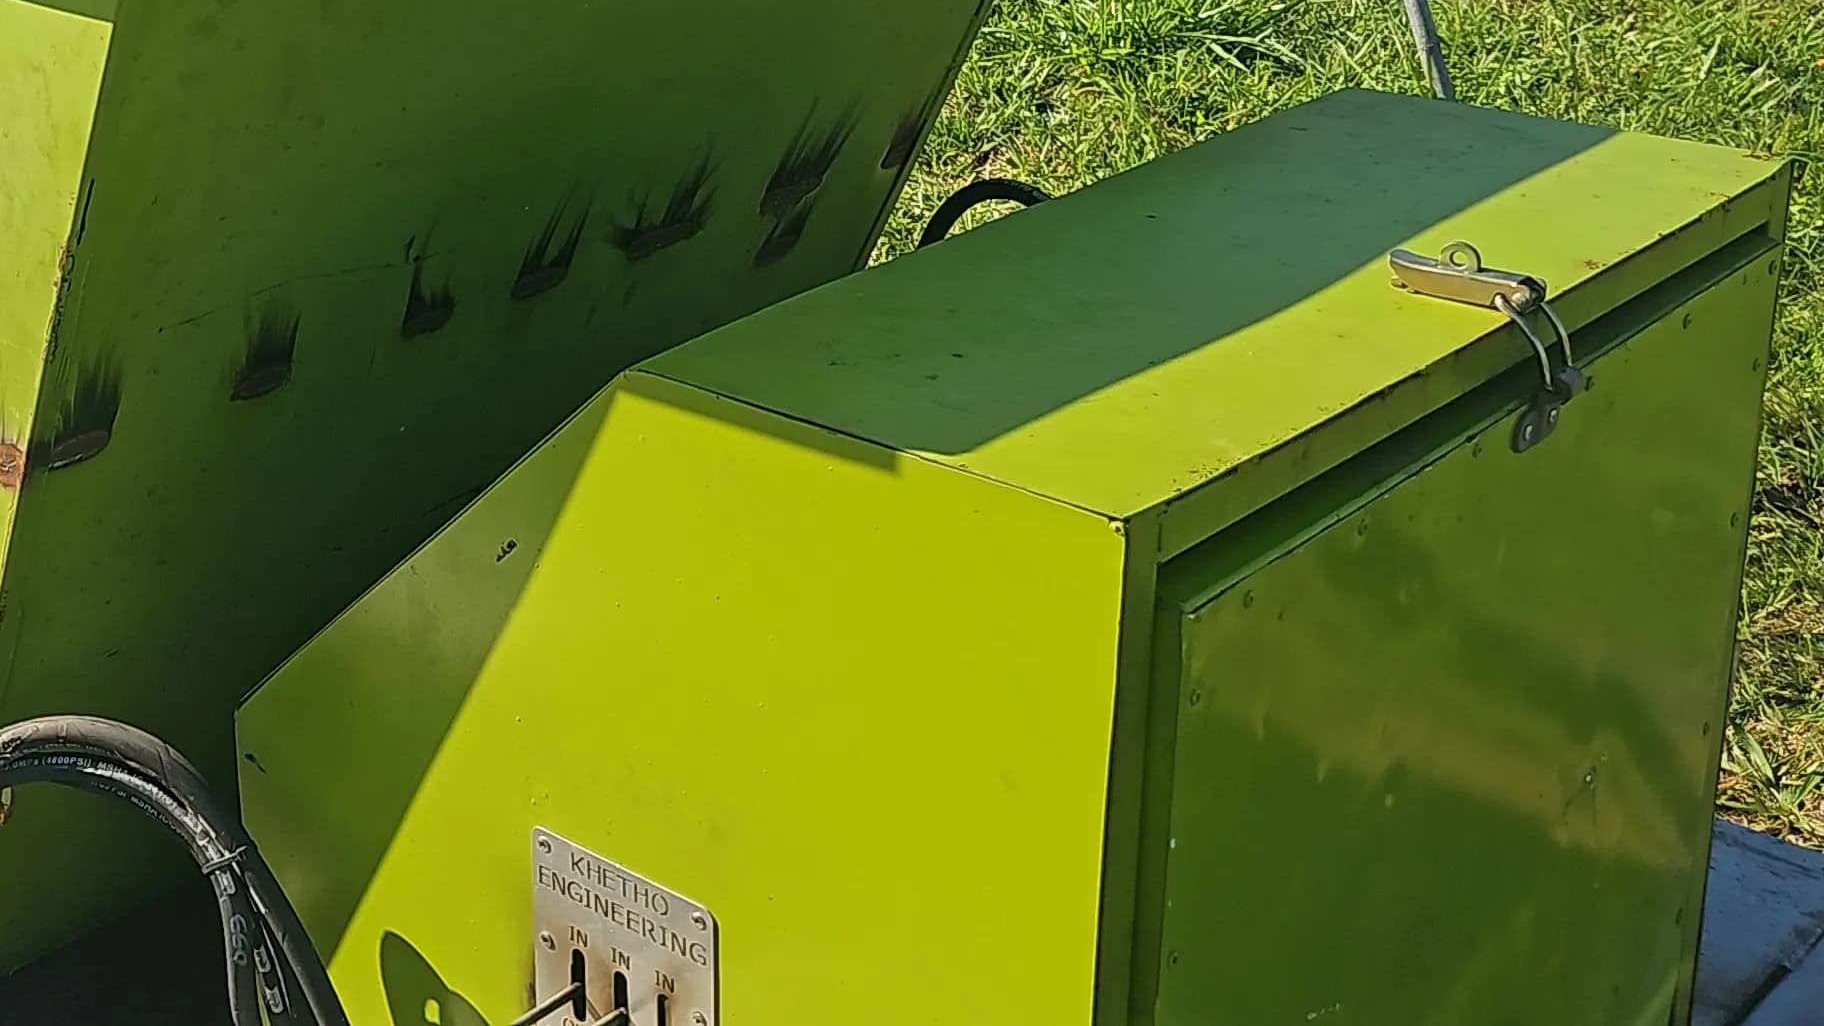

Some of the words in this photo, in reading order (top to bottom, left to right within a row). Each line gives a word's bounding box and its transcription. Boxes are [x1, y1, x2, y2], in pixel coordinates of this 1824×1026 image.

[570, 851, 670, 917] KHETHO
[537, 864, 708, 967] ENGINEERING
[569, 925, 588, 948] IN
[611, 947, 631, 971] IN
[655, 969, 675, 994] IN
